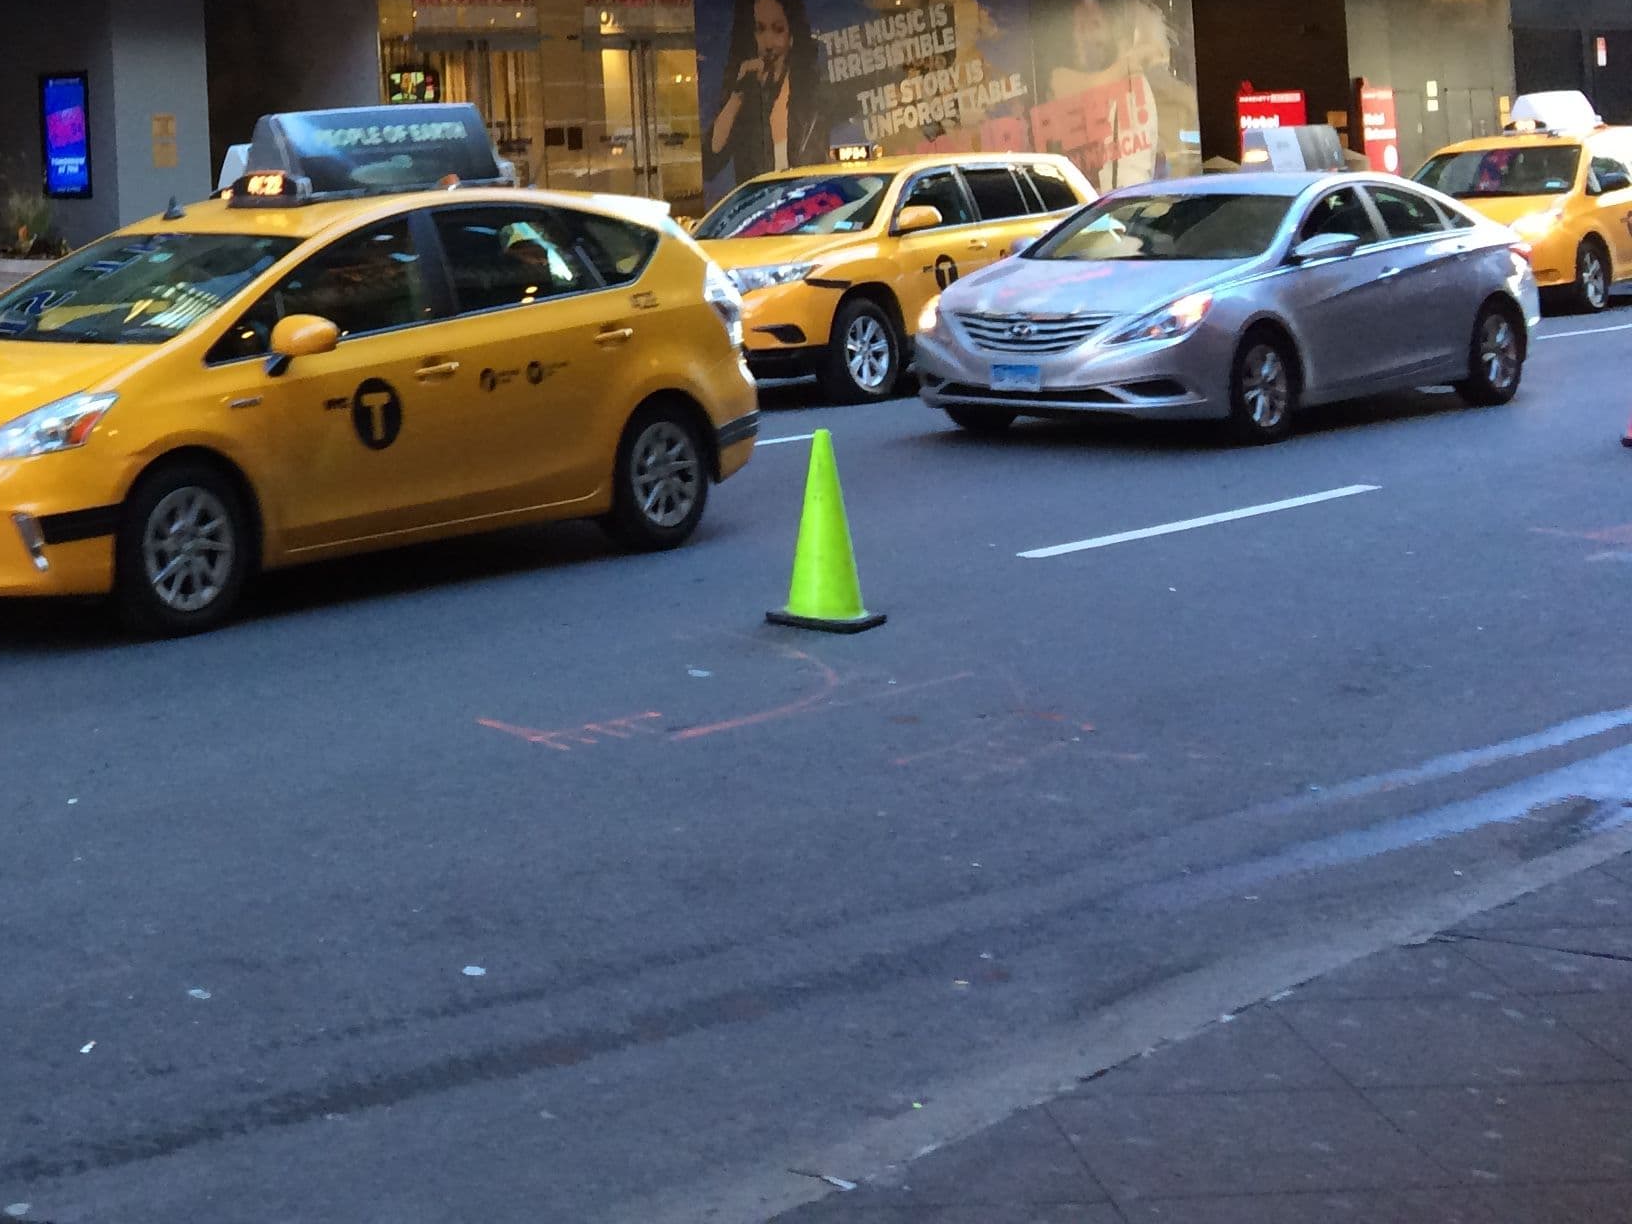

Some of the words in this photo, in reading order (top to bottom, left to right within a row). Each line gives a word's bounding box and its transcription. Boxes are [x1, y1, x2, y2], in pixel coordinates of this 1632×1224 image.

[822, 22, 867, 56] THE
[867, 8, 927, 44] MUSIC
[929, 2, 950, 29] IS
[826, 25, 957, 84] IRRESISTIBLE
[856, 88, 898, 115] THE
[899, 67, 962, 105] STORY
[966, 58, 985, 84] IS
[862, 72, 1028, 142] UNFORGETTABLE.
